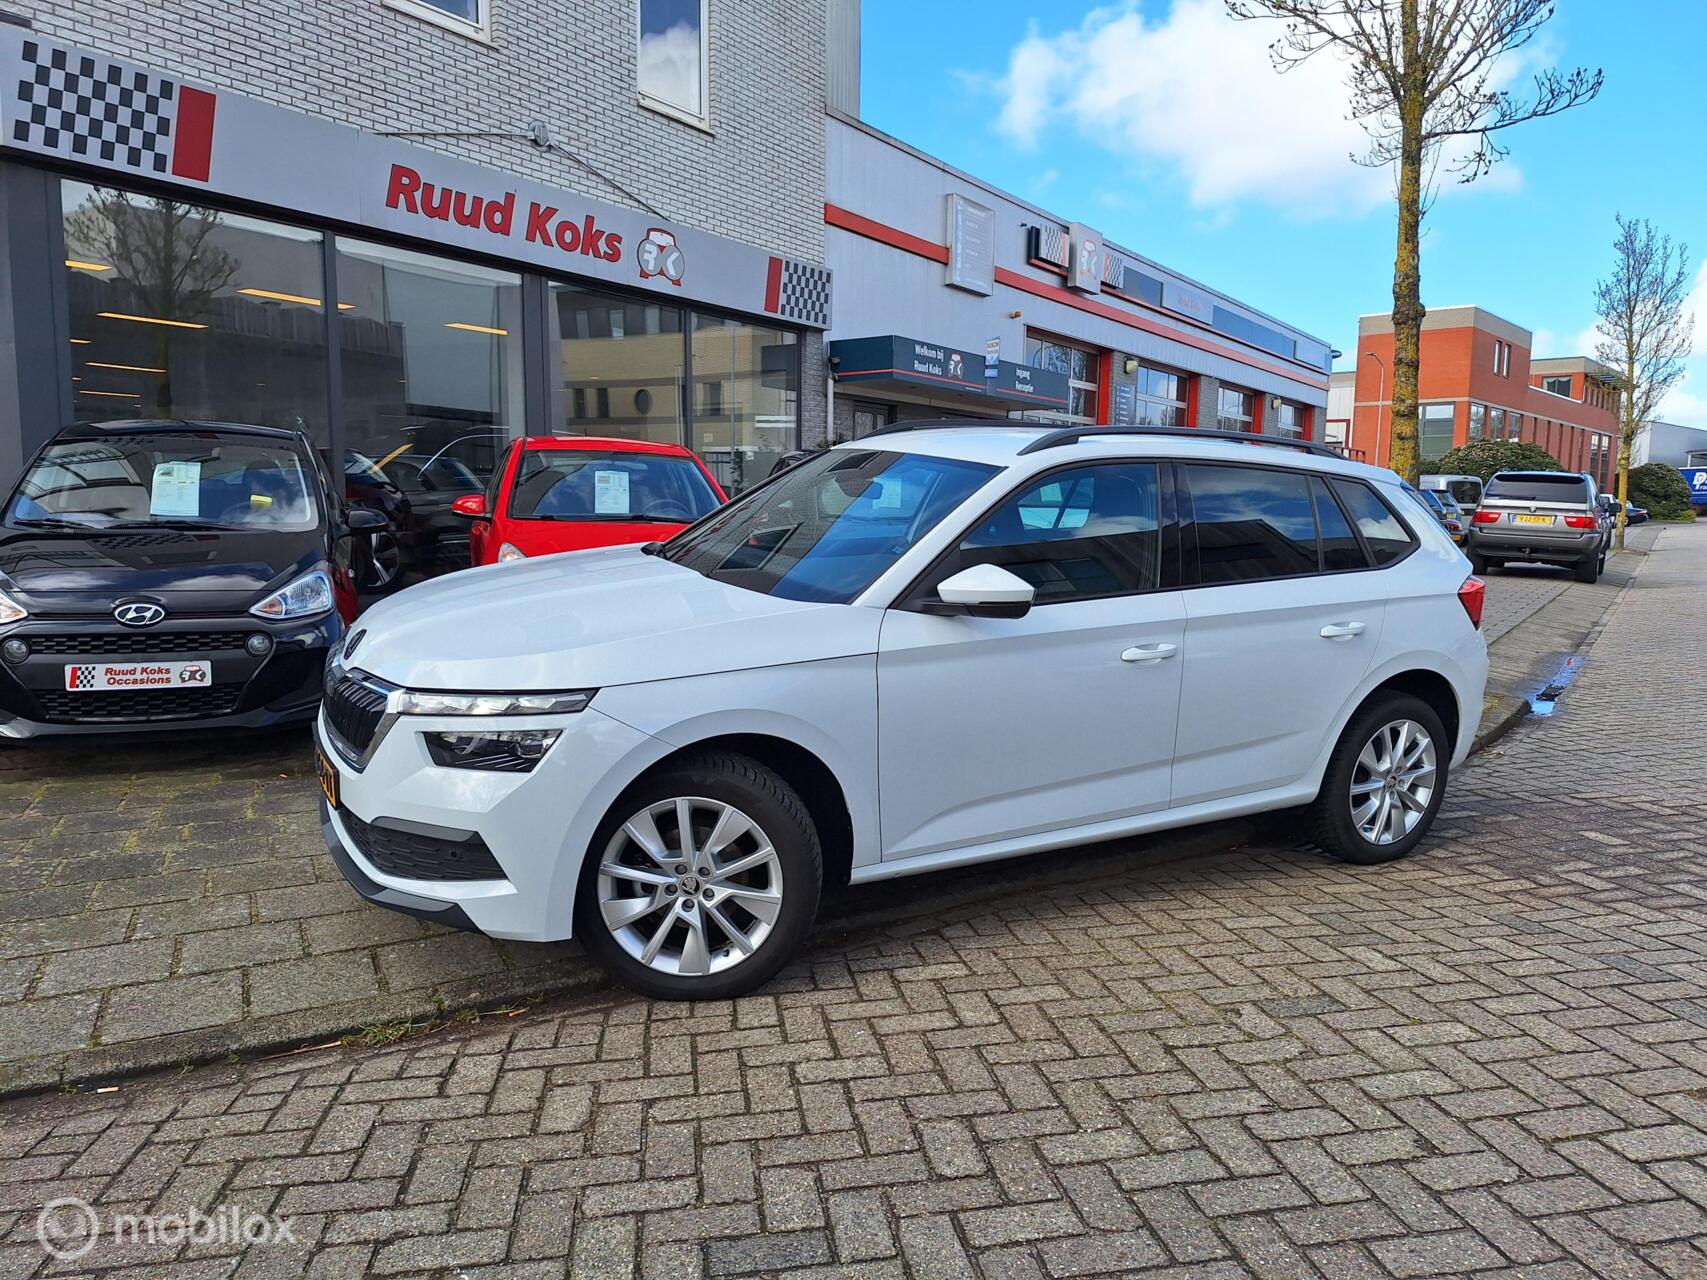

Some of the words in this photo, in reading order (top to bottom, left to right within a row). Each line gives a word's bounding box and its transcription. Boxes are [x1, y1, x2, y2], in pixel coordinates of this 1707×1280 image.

[385, 163, 515, 236] Ruud
[525, 202, 622, 263] Koks
[915, 344, 937, 359] Welkom
[937, 349, 945, 363] bij
[914, 360, 929, 373] Ruud
[929, 363, 942, 376] Koks
[105, 667, 137, 677] Ruud
[140, 666, 171, 676] Koks
[107, 676, 171, 686] Occasions
